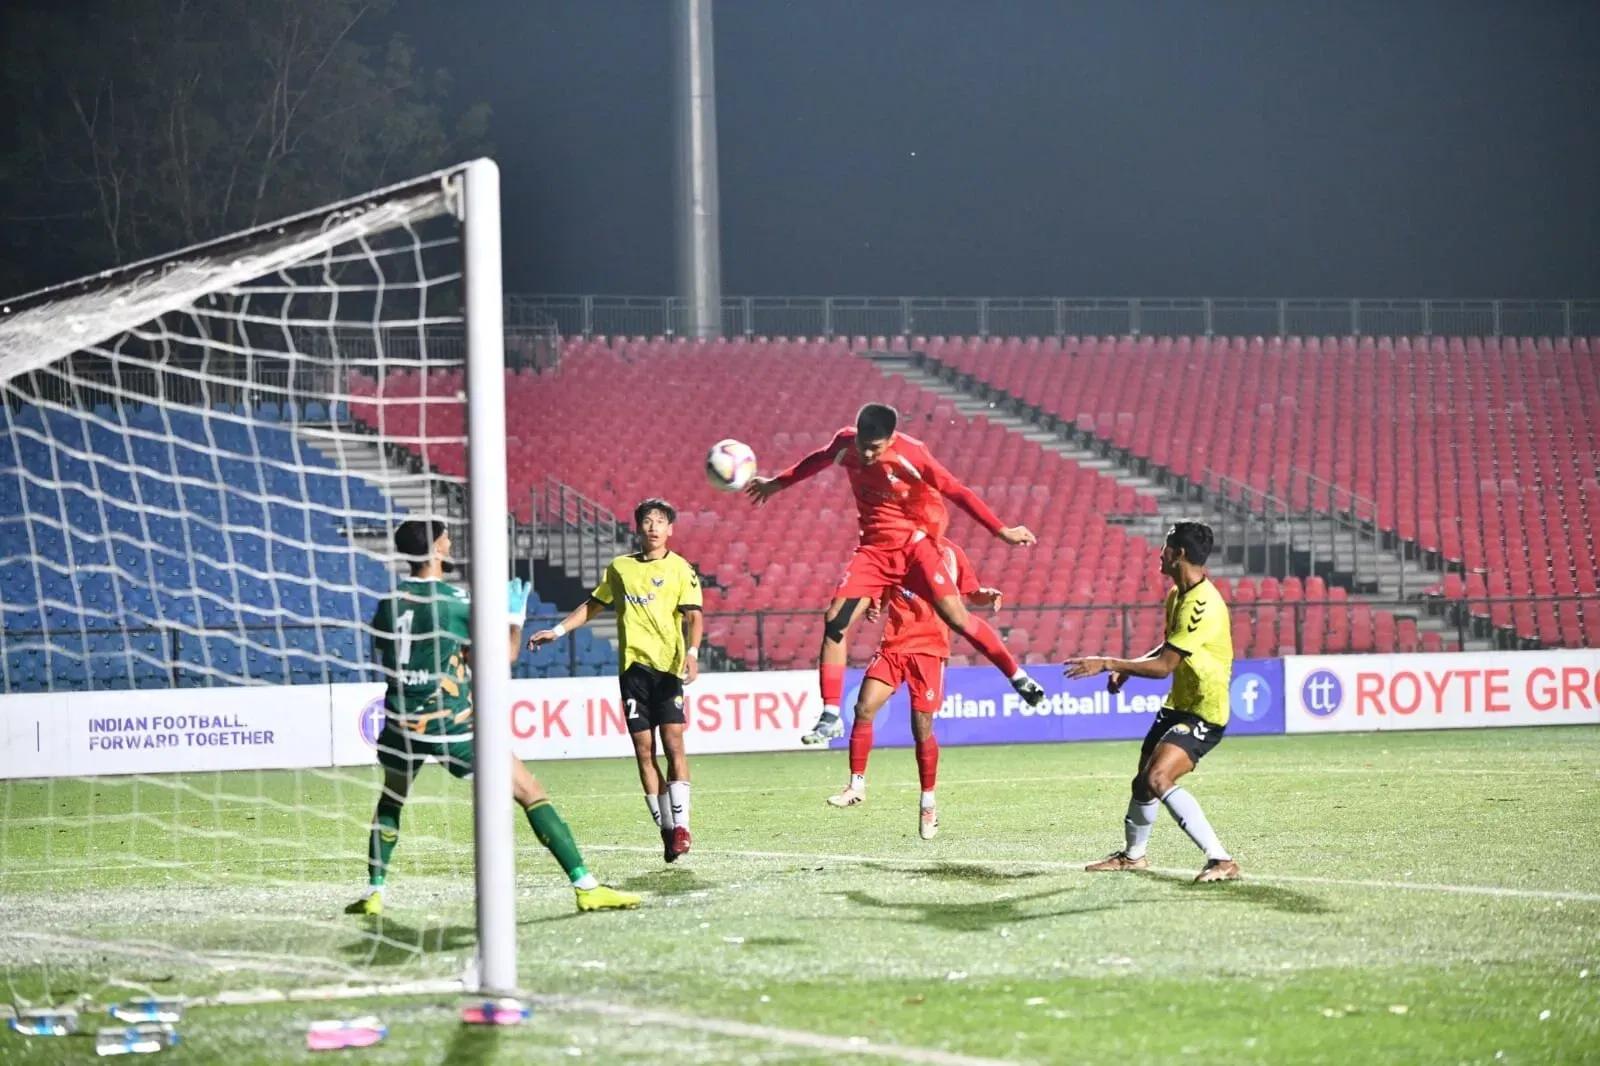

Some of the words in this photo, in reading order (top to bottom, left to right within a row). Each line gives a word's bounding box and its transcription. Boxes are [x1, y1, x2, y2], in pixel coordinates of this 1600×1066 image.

[1003, 690, 1109, 717] Football
[1117, 690, 1168, 714] Lea
[1356, 669, 1511, 716] ROYTE
[88, 716, 148, 733] INDIAN
[152, 713, 248, 731] FOOTBALL.
[587, 691, 808, 736] INSTRY
[89, 733, 180, 751] FORWARD
[185, 730, 275, 746] TOGETHER
